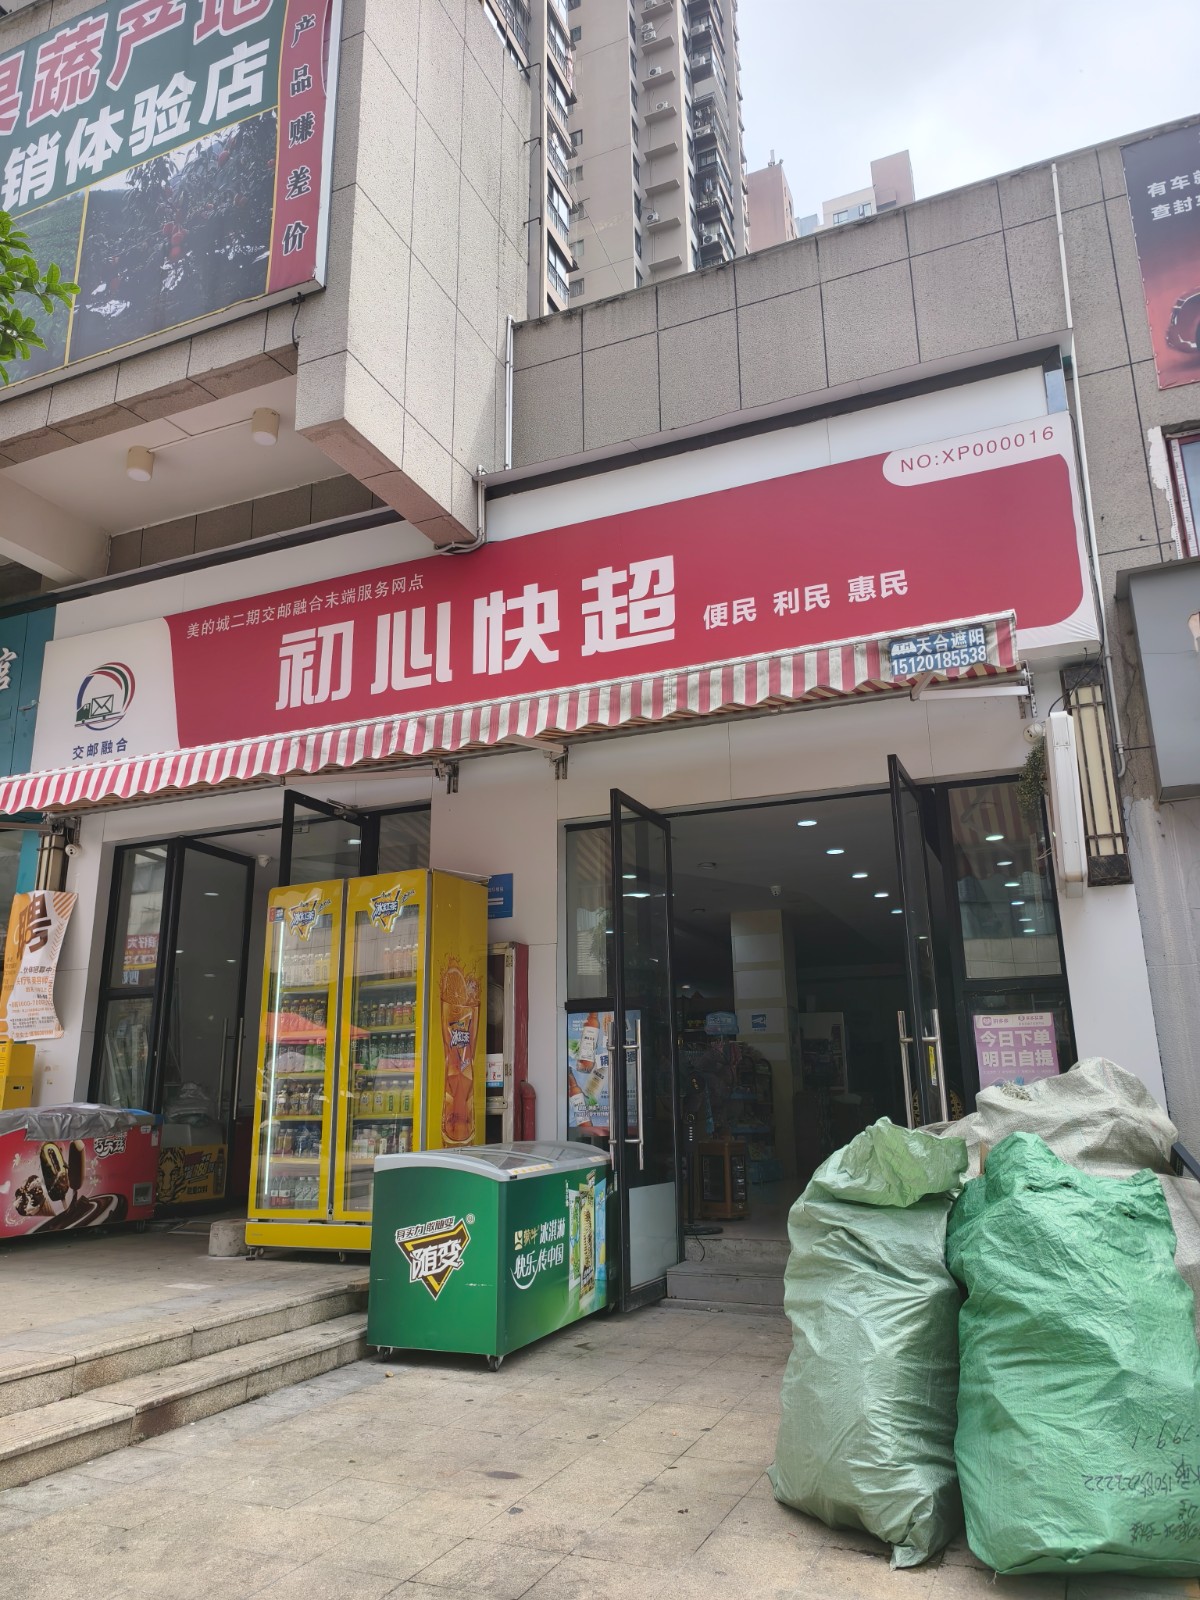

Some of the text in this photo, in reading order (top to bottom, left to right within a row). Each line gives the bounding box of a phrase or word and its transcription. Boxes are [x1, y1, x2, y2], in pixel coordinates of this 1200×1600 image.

[282, 14, 317, 257] 产品赚差价
[900, 426, 1055, 473] NO:XP000016
[186, 573, 425, 639] 美的城二期交邮融合末端服务网点
[703, 569, 909, 630] 便民 利民 惠民
[275, 554, 676, 711] 初心快超
[916, 628, 985, 655] 天合遮阳
[892, 646, 987, 675] 15120185538
[72, 738, 128, 761] 交邮融合
[980, 1029, 1052, 1048] 今日下单
[982, 1049, 1054, 1068] 明日自提
[540, 1217, 565, 1244] 冰淇淋
[410, 1239, 463, 1280] 随变
